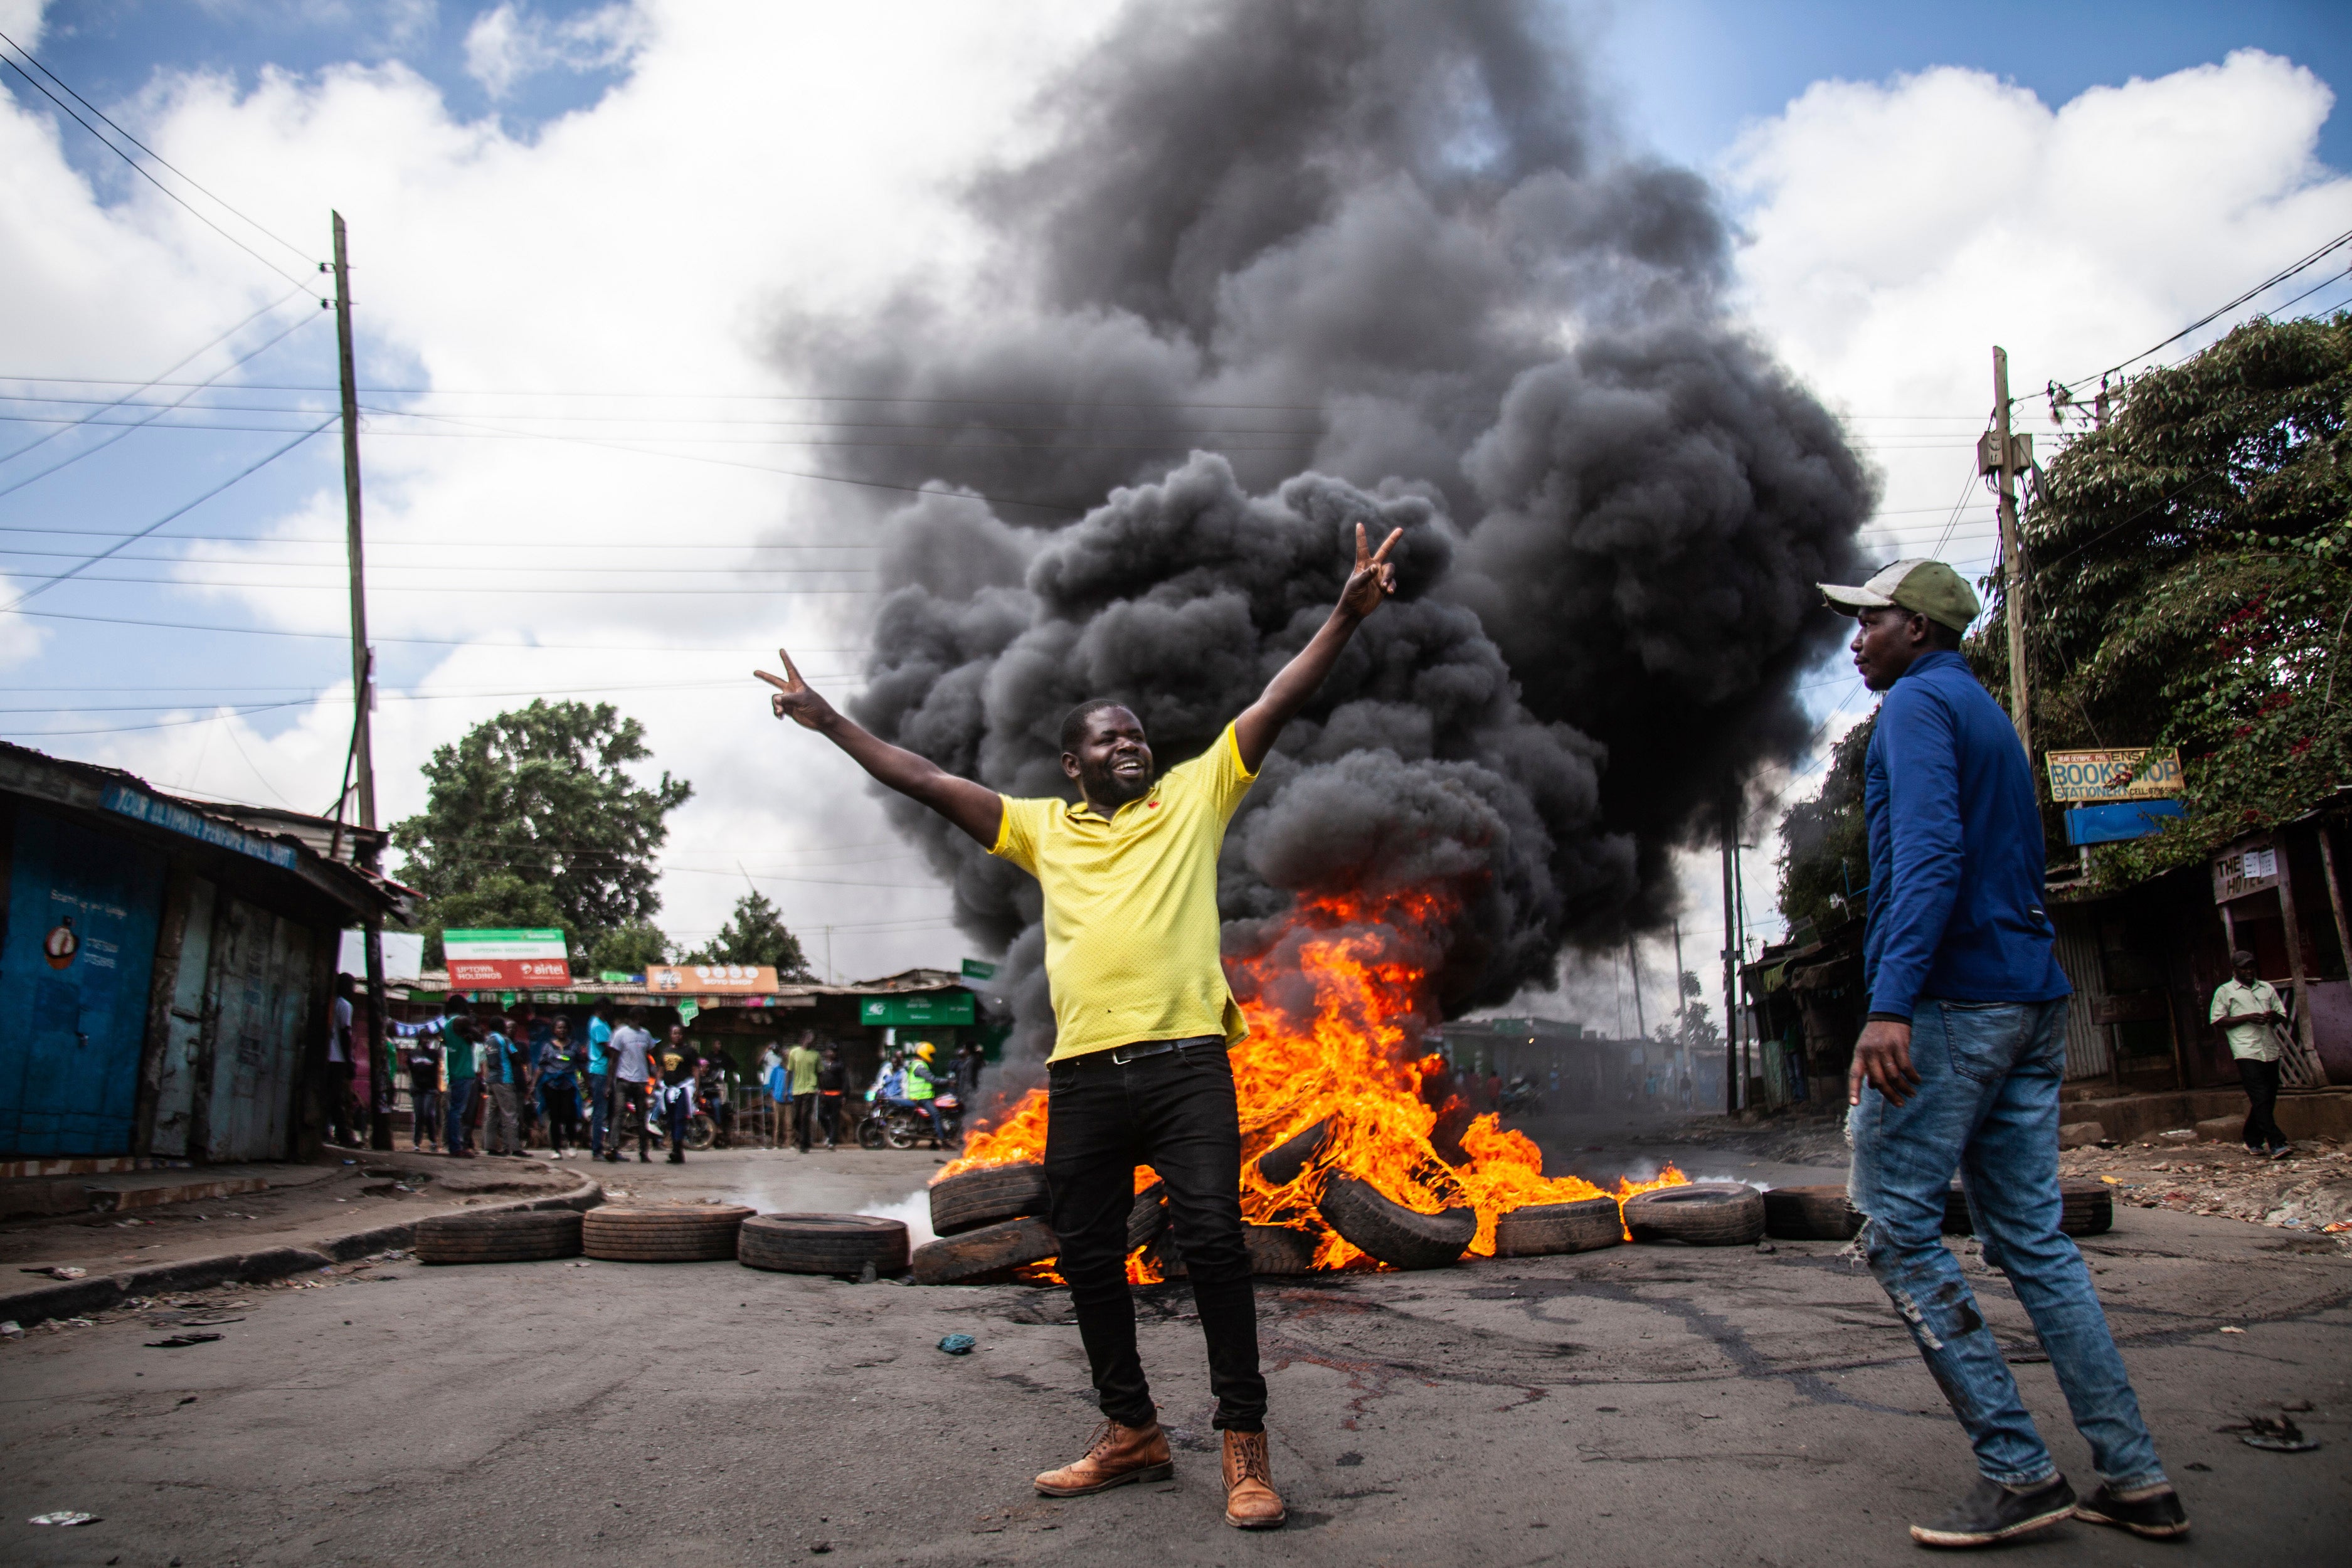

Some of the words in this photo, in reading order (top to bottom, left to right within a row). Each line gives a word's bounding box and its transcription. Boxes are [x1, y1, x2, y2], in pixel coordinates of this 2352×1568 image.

[2050, 761, 2179, 786] BOOKSOP
[2217, 856, 2241, 877] THE
[456, 965, 494, 973] UPTOWN
[534, 963, 564, 975] airtel
[458, 972, 502, 980] HOLDINGS
